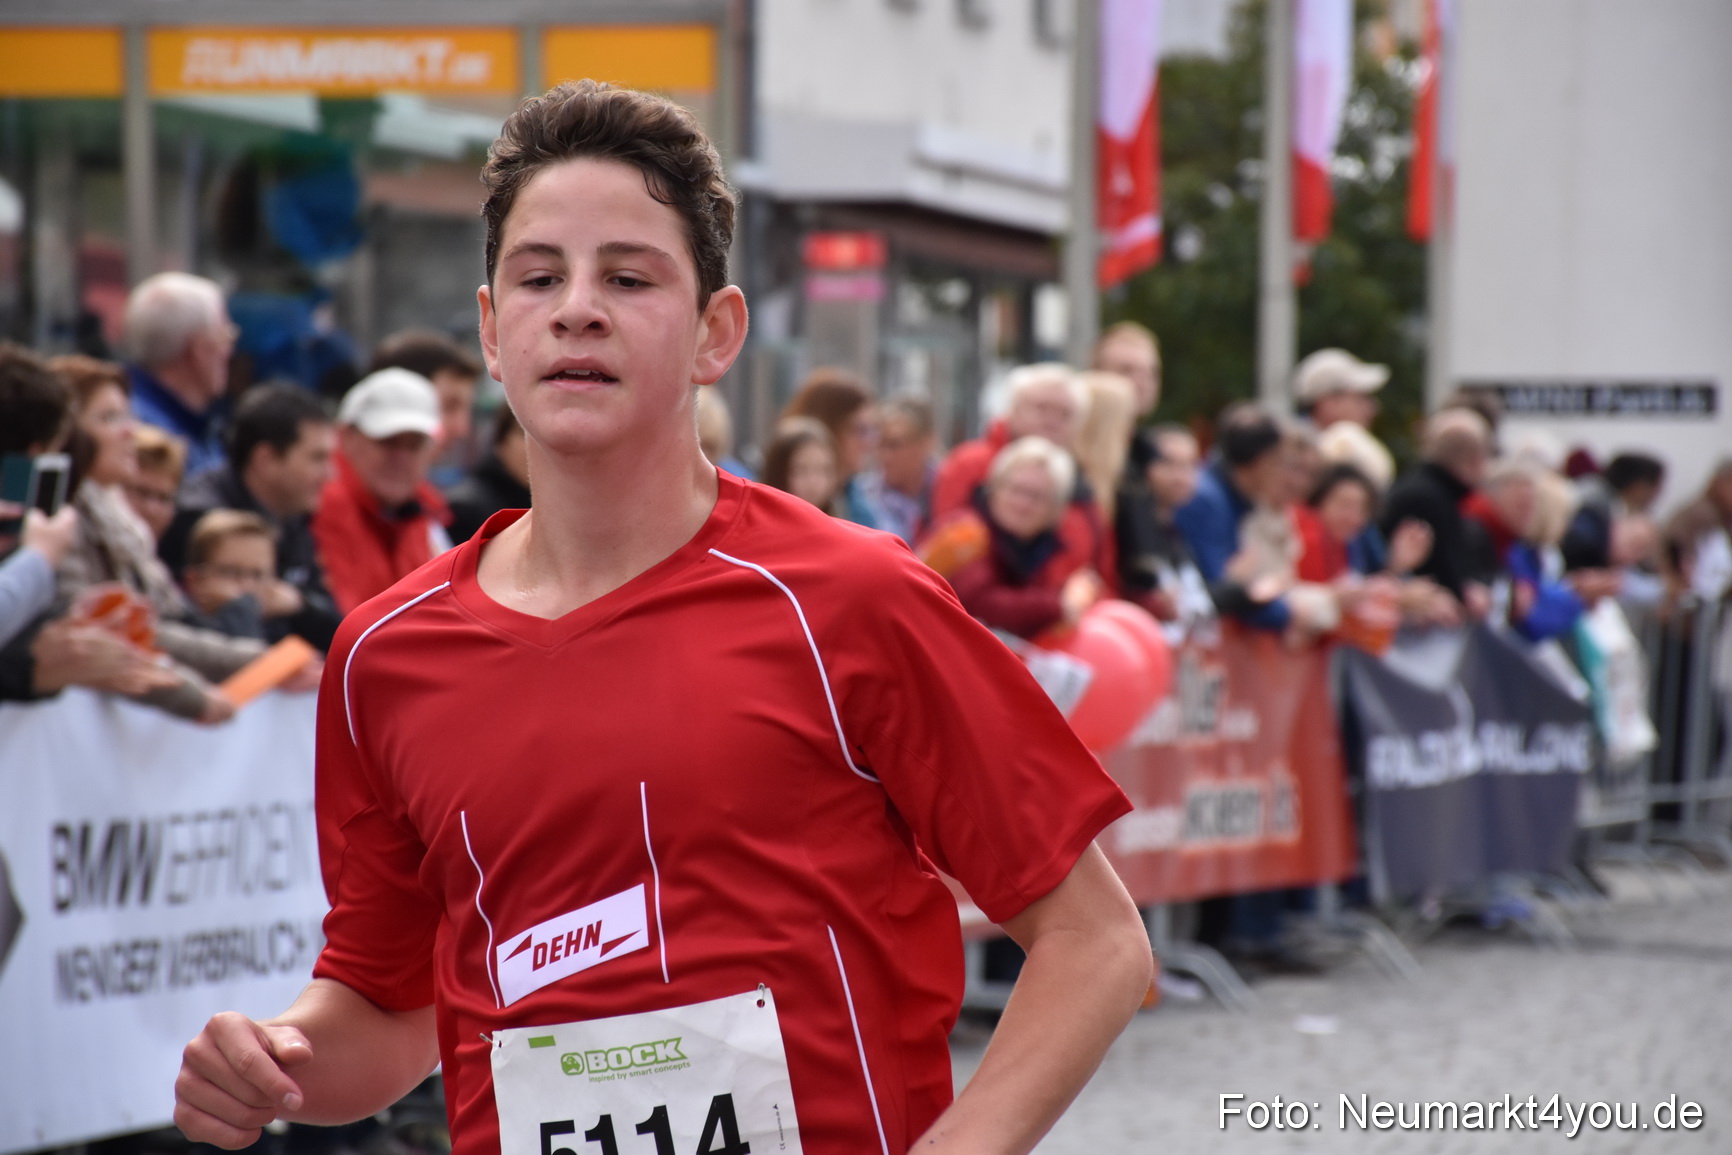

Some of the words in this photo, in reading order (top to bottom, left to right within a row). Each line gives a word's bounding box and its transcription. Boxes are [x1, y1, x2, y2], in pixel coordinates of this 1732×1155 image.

[52, 816, 162, 914] BMW
[532, 919, 603, 972] DEHN
[584, 1037, 688, 1074] BOCK
[588, 1072, 615, 1083] inspired
[617, 1070, 627, 1080] by
[629, 1067, 653, 1078] smart
[654, 1061, 691, 1074] concepts
